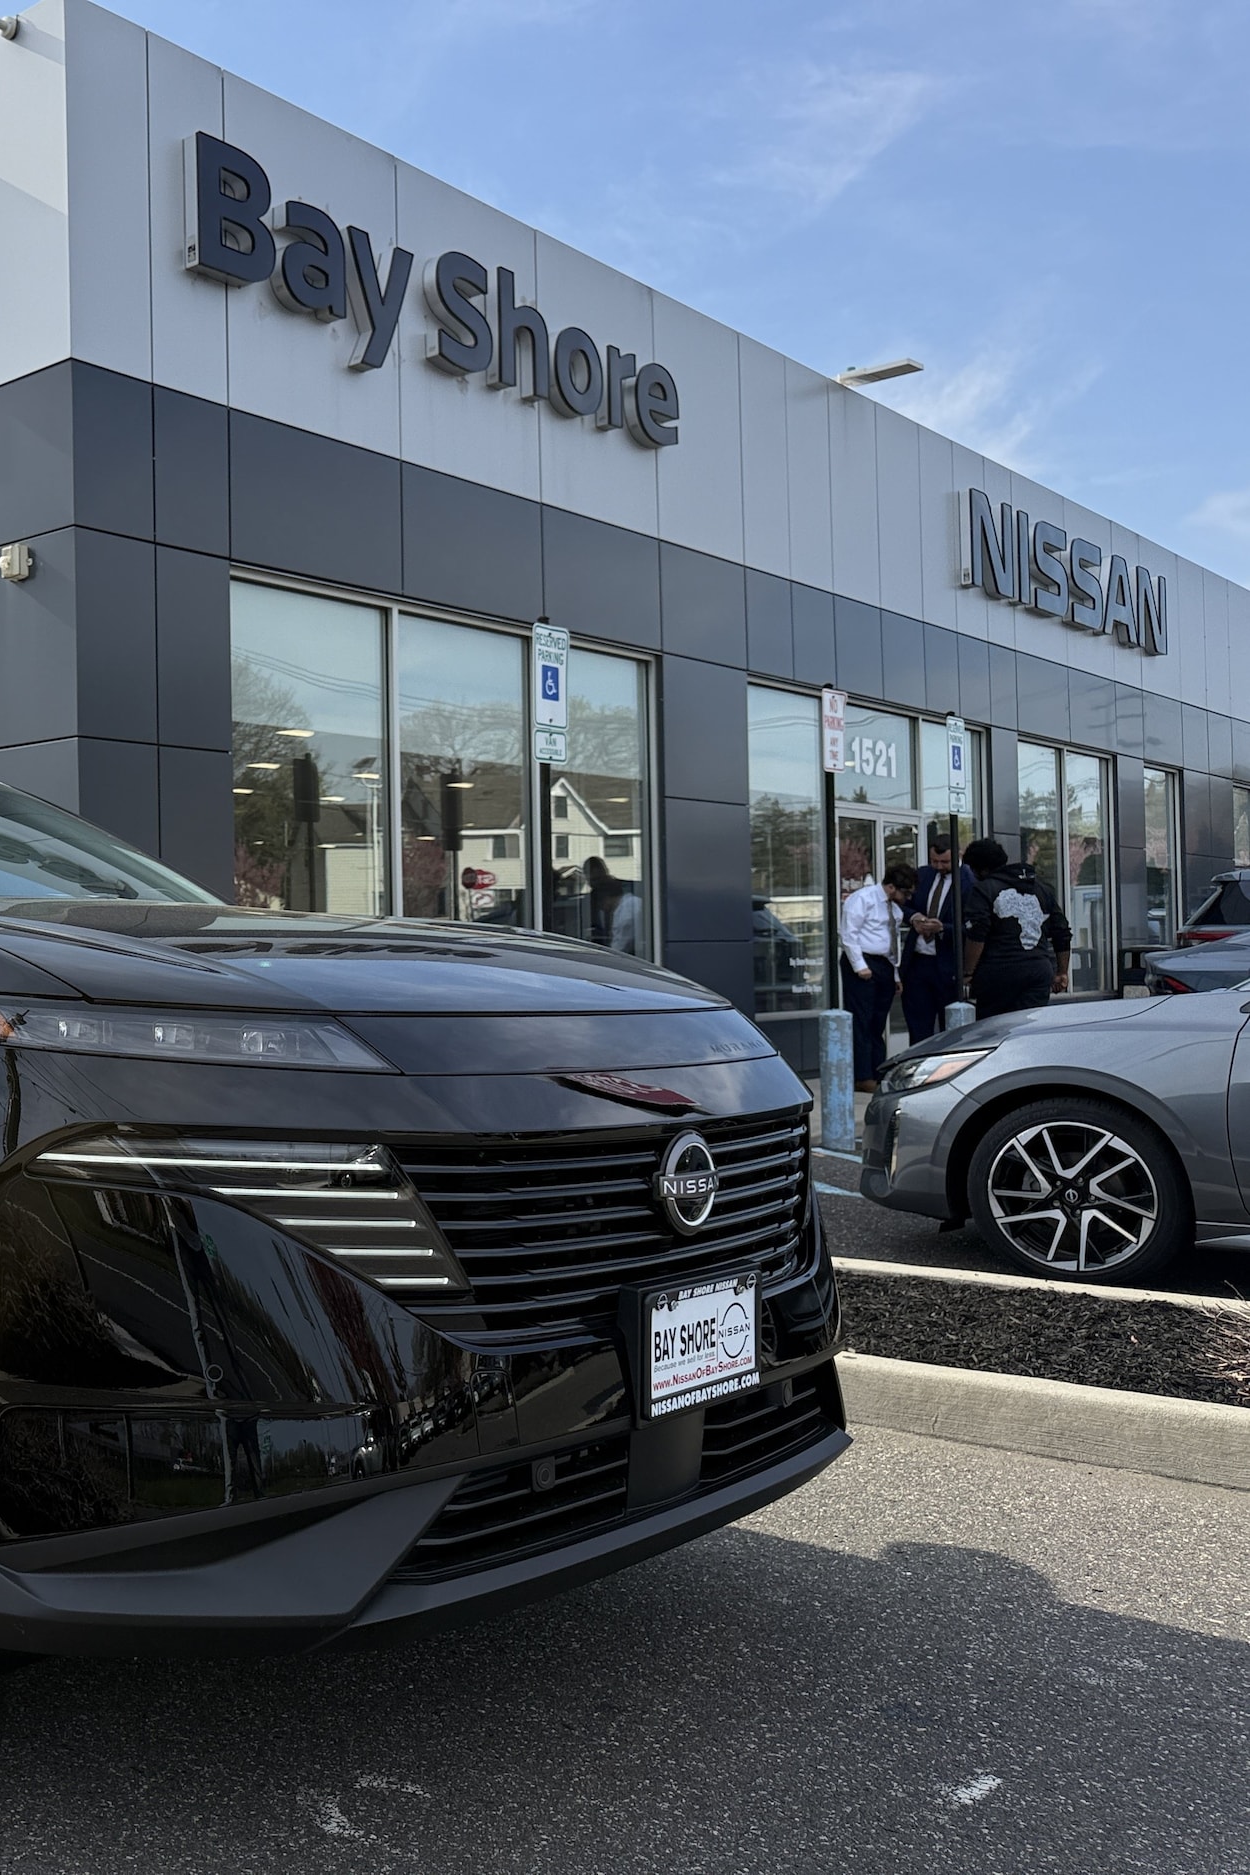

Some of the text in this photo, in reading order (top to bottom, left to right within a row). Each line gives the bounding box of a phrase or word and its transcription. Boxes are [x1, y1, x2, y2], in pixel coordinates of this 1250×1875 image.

[184, 131, 680, 448] Bay Shore
[959, 488, 1168, 656] NISSAN
[535, 632, 566, 651] RESERVED
[538, 648, 564, 666] PARKING
[829, 698, 839, 714] NO
[851, 736, 897, 778] 1521
[678, 1278, 738, 1300] BAY SHORE NISSAN
[654, 1317, 716, 1363] BAY SHORE
[718, 1322, 751, 1339] NISSAN
[654, 1362, 677, 1373] Because
[651, 1371, 760, 1418] NISSANOFBAYSHORE.COM
